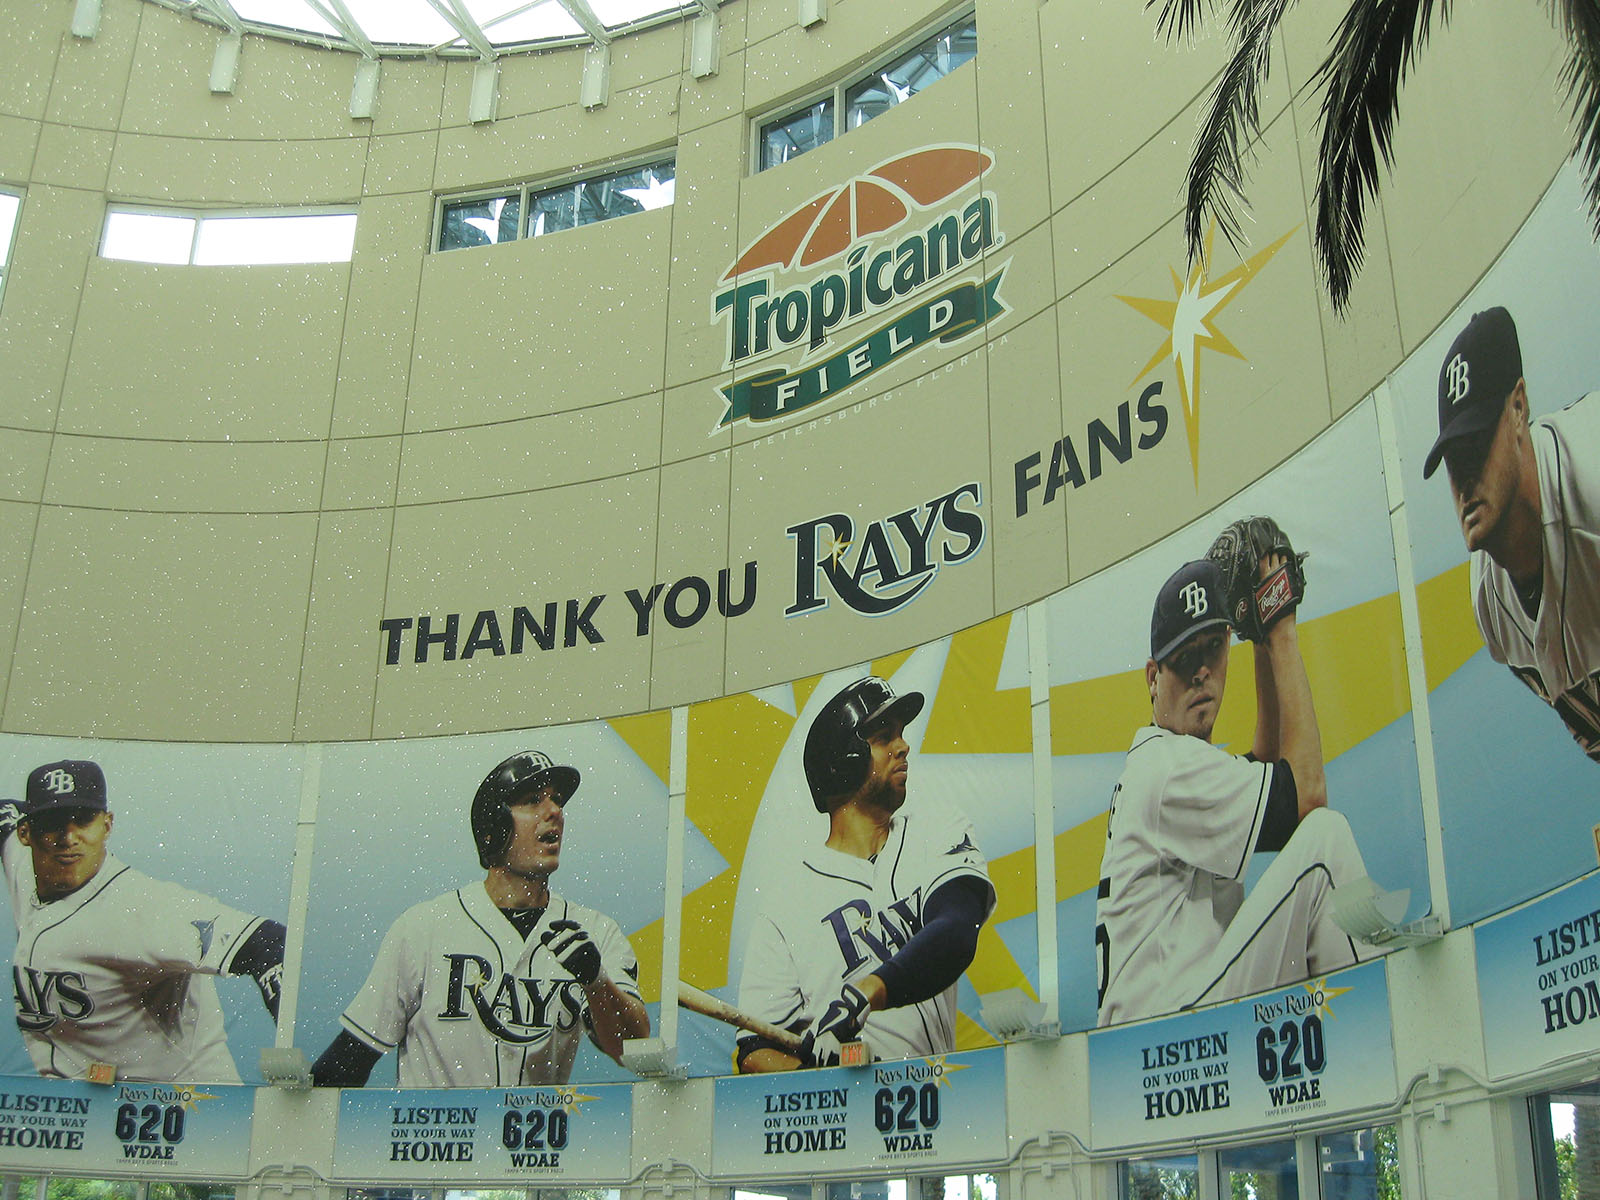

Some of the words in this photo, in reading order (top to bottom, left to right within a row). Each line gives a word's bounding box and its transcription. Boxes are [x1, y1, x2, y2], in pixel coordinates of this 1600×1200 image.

[713, 196, 996, 364] Tropicana
[776, 299, 955, 411] FIELD
[916, 336, 1008, 388] FLORIDA
[380, 595, 606, 666] THANK
[624, 560, 757, 637] YOU
[784, 481, 984, 619] RAYS
[1014, 379, 1169, 517] FANS
[1179, 581, 1209, 619] TB
[44, 769, 75, 794] TB
[1538, 970, 1558, 991] ON
[1562, 954, 1600, 984] YOUR
[438, 953, 584, 1046] RAYS
[1142, 1032, 1229, 1070] LISTEN
[1256, 1014, 1327, 1085] 620
[1143, 1077, 1161, 1088] ON
[1164, 1069, 1199, 1085] YOUR
[1203, 1062, 1229, 1078] WAY
[0, 1093, 92, 1114] LISTEN
[764, 1088, 849, 1114] LISTEN
[1144, 1081, 1230, 1120] HOME
[1269, 1079, 1321, 1107] WDAE
[20, 1115, 56, 1126] YOUR
[61, 1118, 88, 1128] WAY
[393, 1107, 478, 1125] LISTEN
[764, 1117, 781, 1128] ON
[786, 1114, 818, 1127] YOUR
[822, 1112, 847, 1124] WAY
[875, 1082, 941, 1134] 620
[115, 1103, 187, 1144] 620
[391, 1129, 409, 1138] ON
[412, 1129, 446, 1138] YOUR
[450, 1128, 475, 1138] WAY
[502, 1109, 569, 1151] 620
[123, 1144, 175, 1159] WDAE
[390, 1142, 473, 1162] HOME
[764, 1128, 846, 1154] HOME
[883, 1133, 933, 1153] WDAE
[511, 1153, 560, 1167] WDAE
